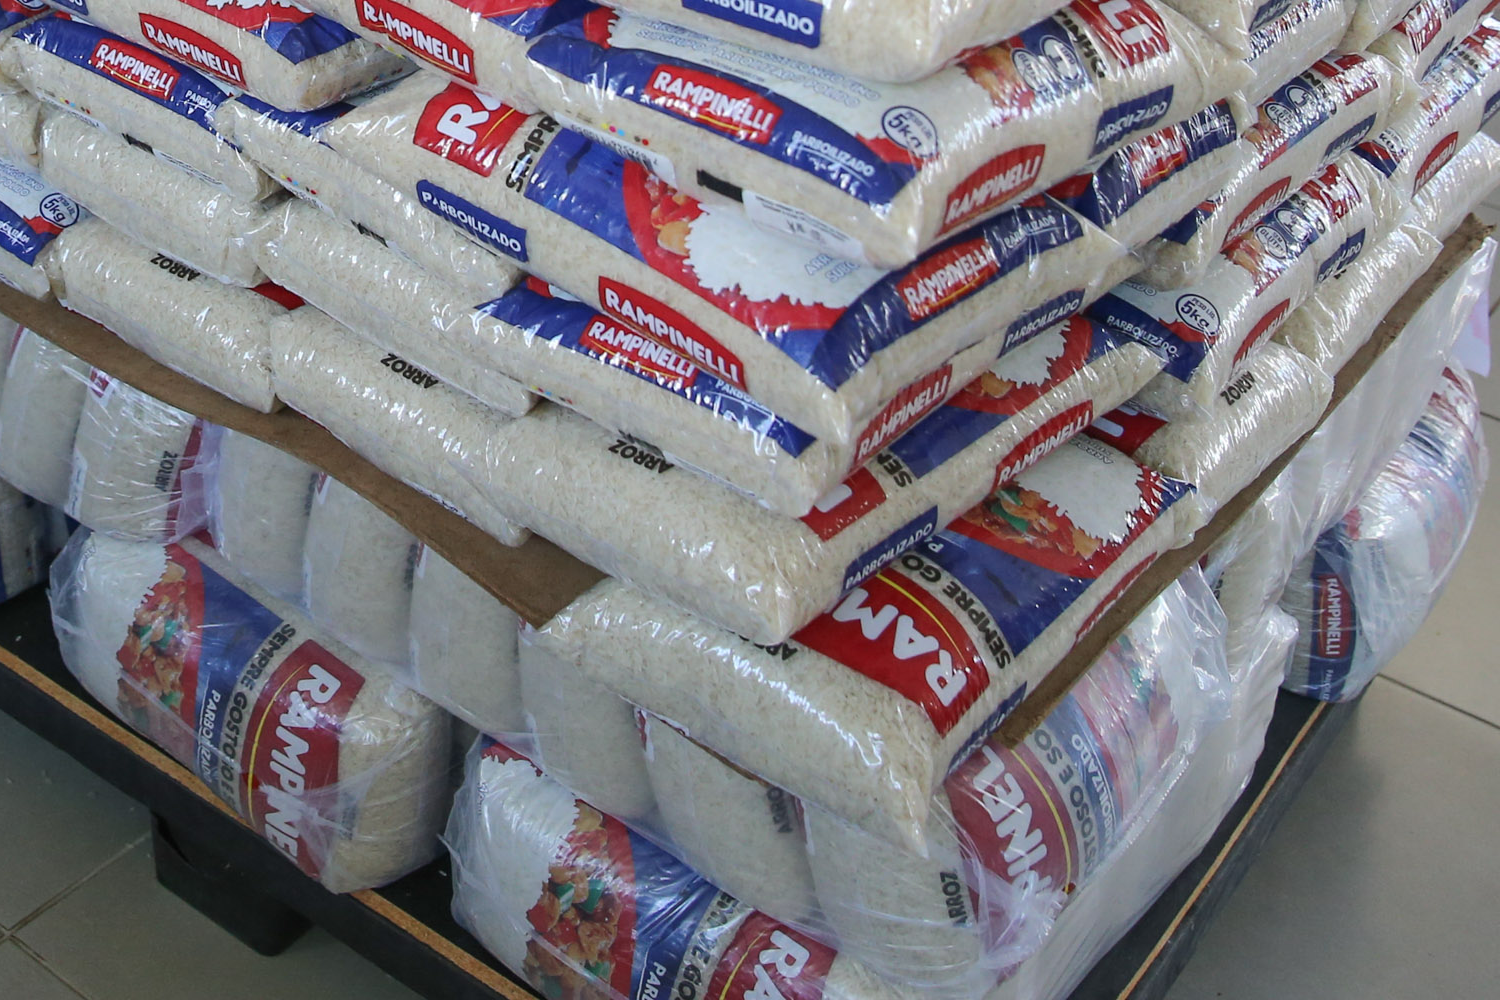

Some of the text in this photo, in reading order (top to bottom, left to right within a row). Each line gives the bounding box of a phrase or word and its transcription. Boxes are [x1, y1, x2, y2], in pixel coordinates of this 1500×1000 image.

[145, 22, 241, 83] RAMPINELLI
[362, 0, 471, 74] RAMPINELLI
[96, 44, 174, 94] RAMPINELLI
[652, 71, 775, 132] RAMPINELLI
[791, 130, 876, 179] PARBOILIZADO
[43, 198, 66, 224] 5kg
[946, 155, 1042, 222] RAMPINELLI
[422, 191, 522, 254] PARBOILIZADO
[151, 253, 200, 282] ARROZ
[806, 254, 831, 277] ARR
[605, 288, 740, 383] RAMPINELLI
[1005, 298, 1081, 348] PARBOILIZADO
[1106, 314, 1179, 358] PARBOILIZADO
[1181, 300, 1212, 330] 5kg
[381, 352, 439, 391] ARROZ
[588, 322, 697, 379] RAMPINELLI
[858, 374, 949, 459] RAMPINELLI
[1000, 409, 1091, 484] RAMPINELLI
[608, 440, 674, 475] ARROZ
[845, 521, 933, 591] PARBOILIZADO
[942, 582, 1012, 671] SEMPRE
[1324, 577, 1341, 656] RAMPINELLI
[239, 623, 296, 697] SEMPRE
